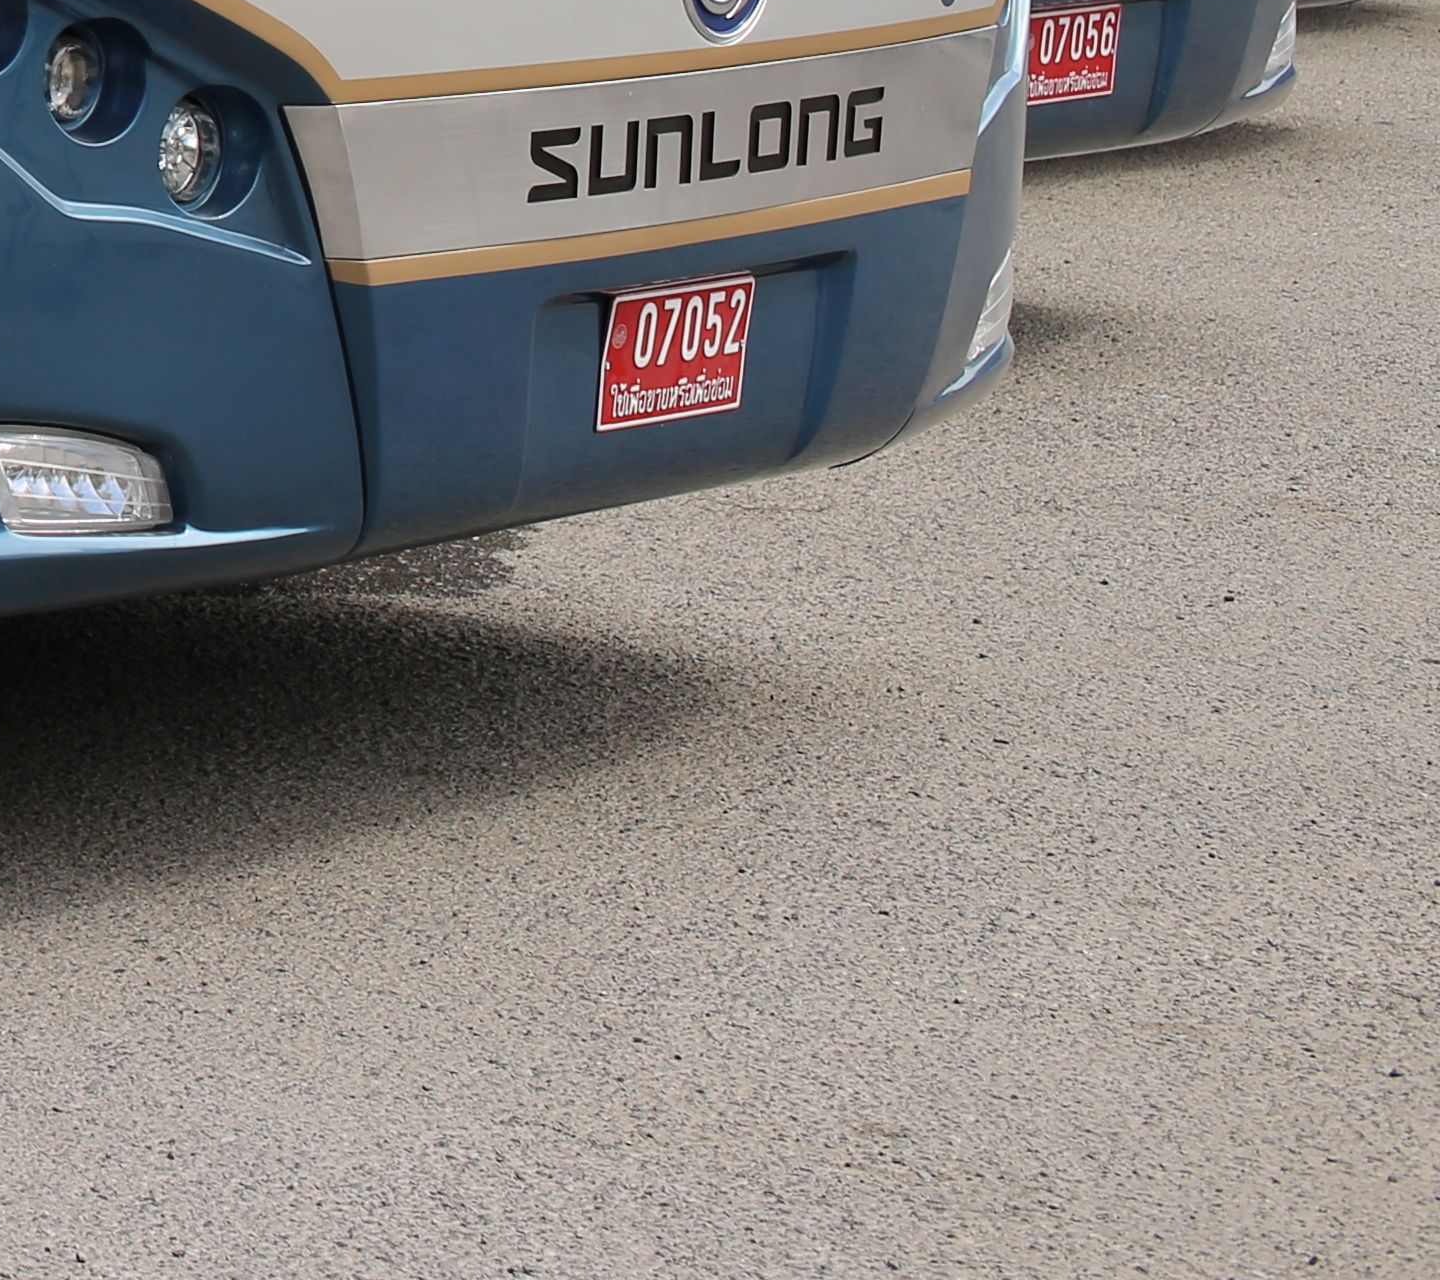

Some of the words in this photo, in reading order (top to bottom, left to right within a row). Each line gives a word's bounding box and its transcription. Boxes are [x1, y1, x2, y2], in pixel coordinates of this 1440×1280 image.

[1039, 11, 1116, 65] 07056
[526, 86, 886, 204] SUNLONG
[633, 288, 747, 369] 07052
